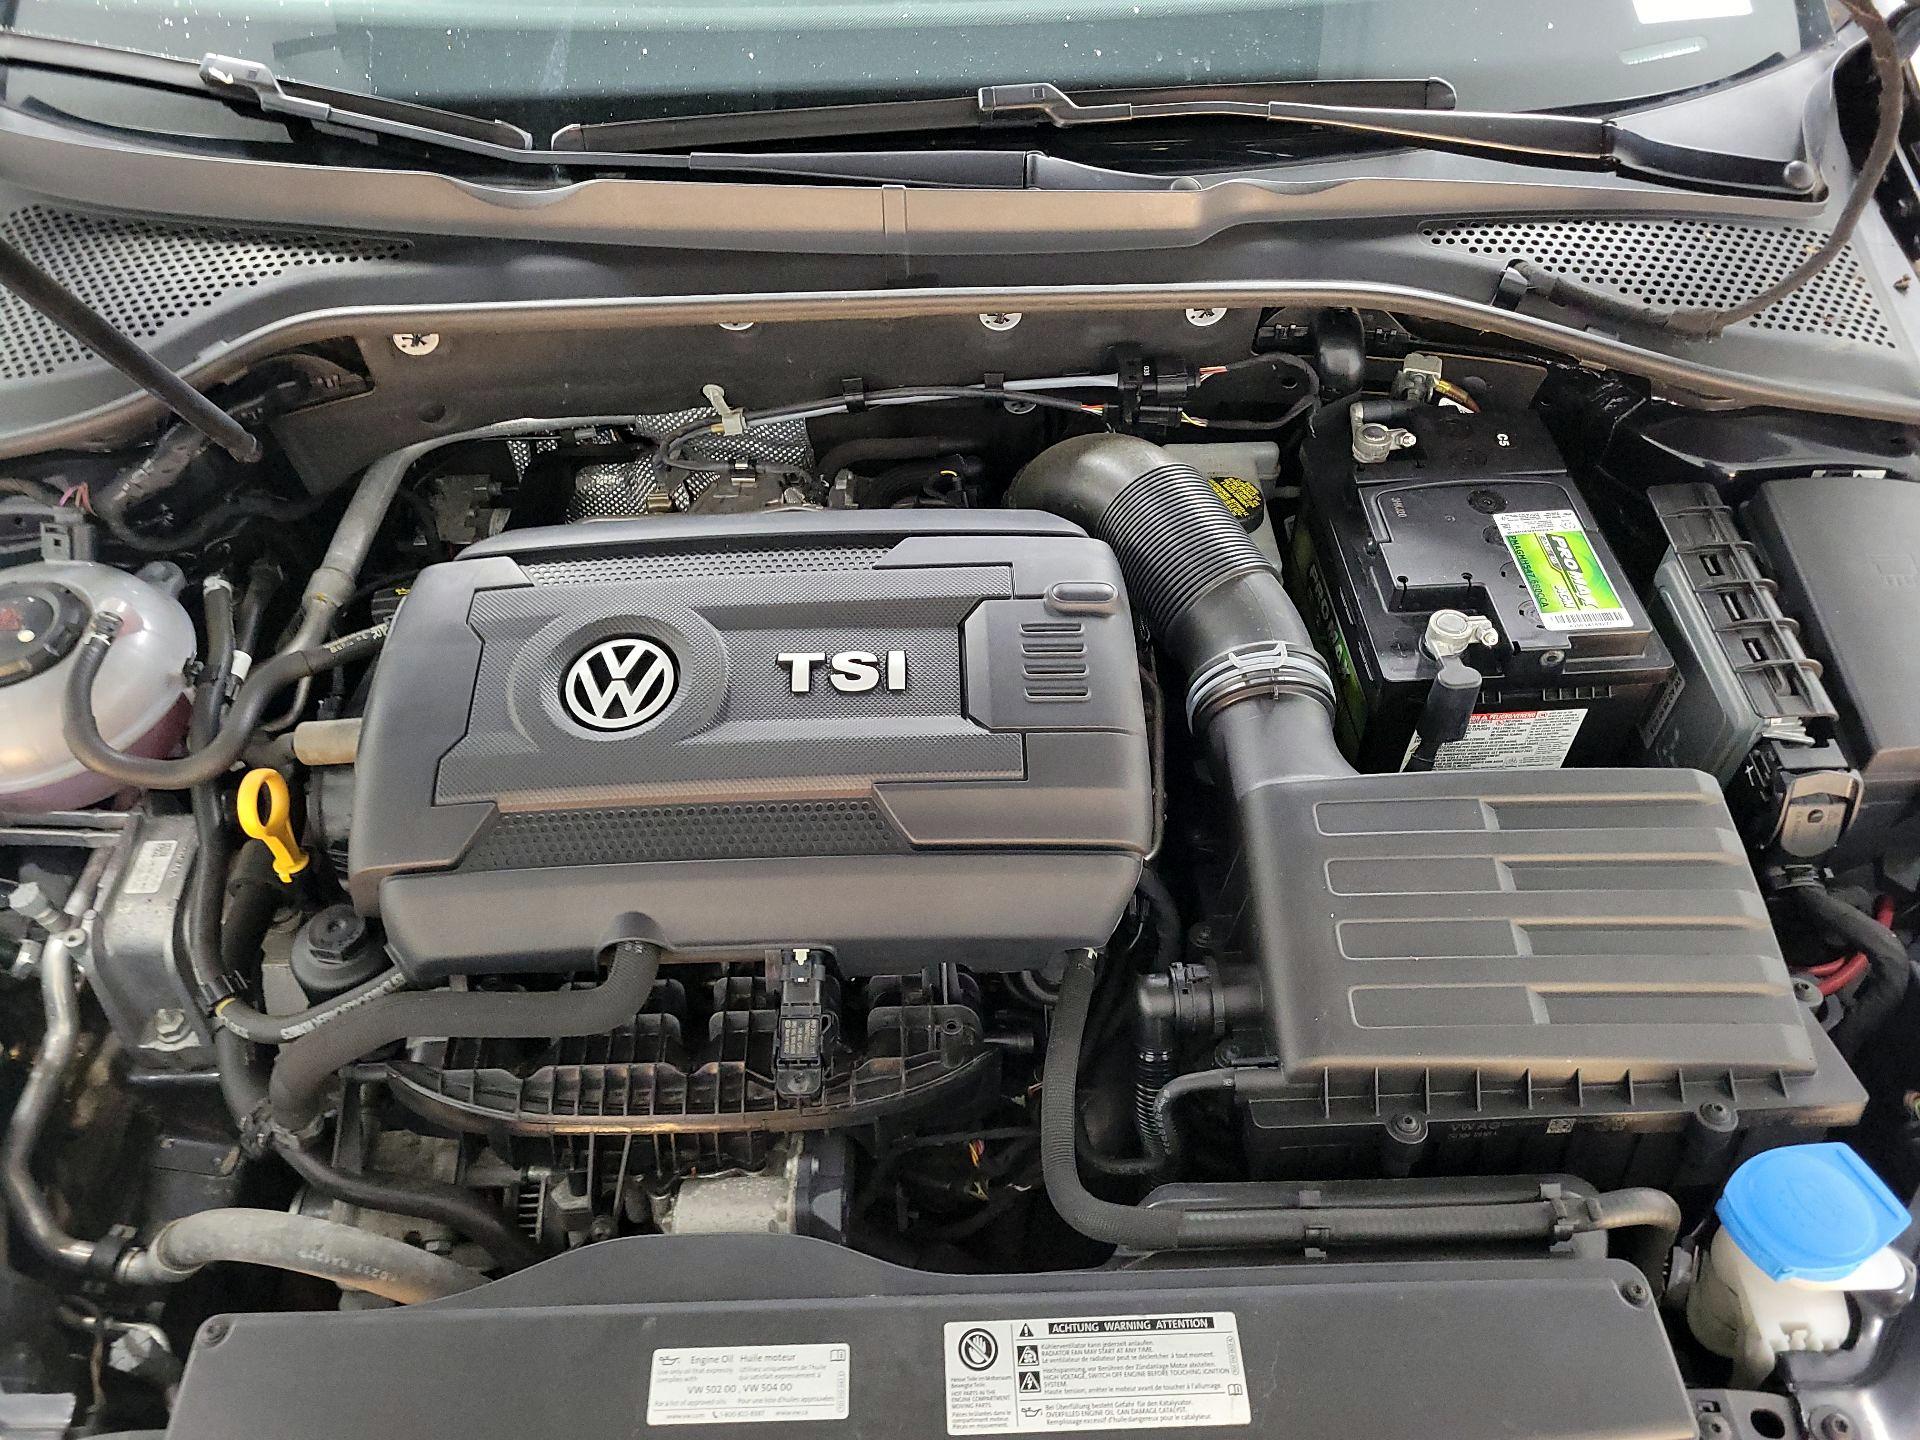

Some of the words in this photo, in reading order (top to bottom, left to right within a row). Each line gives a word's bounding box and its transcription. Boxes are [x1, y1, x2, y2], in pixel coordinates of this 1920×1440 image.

[1496, 433, 1510, 447] C5
[776, 650, 908, 693] TSI
[1052, 1322, 1099, 1333] ACHTUNG
[1104, 1320, 1151, 1331] WARNING
[1155, 1318, 1208, 1330] ATTENTION
[690, 1355, 719, 1366] Engine
[721, 1354, 734, 1363] Oil
[740, 1352, 762, 1362] Huile
[764, 1353, 796, 1361] moteur
[687, 1385, 704, 1394] VW
[705, 1384, 722, 1394] 502
[723, 1384, 736, 1393] 00
[742, 1383, 760, 1392] VW
[761, 1382, 778, 1392] 504
[780, 1382, 793, 1391] 00
